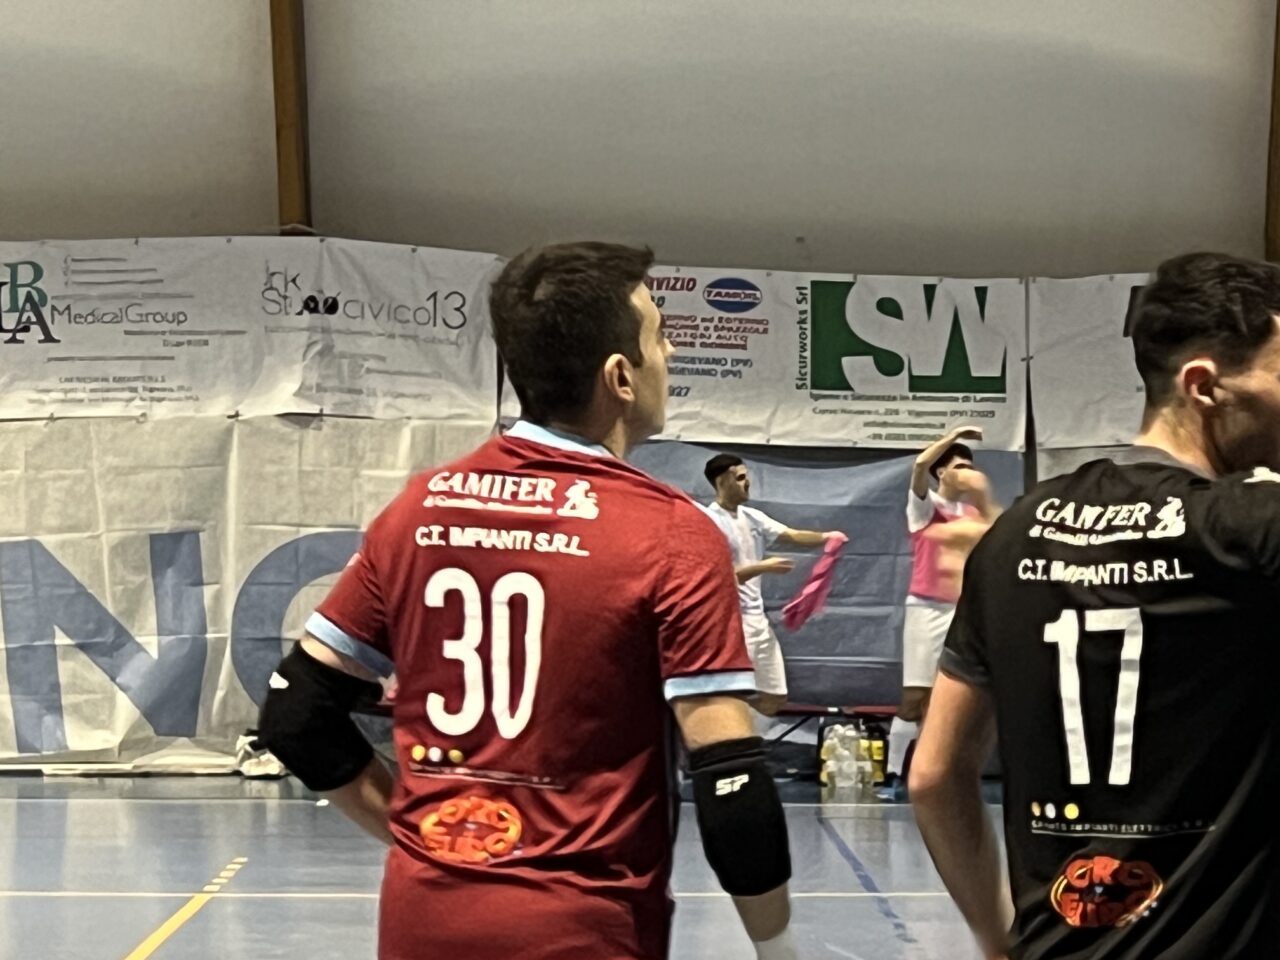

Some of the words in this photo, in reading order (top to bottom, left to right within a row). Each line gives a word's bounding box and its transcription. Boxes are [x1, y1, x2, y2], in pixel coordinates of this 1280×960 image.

[428, 471, 557, 502] GAMIFER
[424, 568, 545, 740] 30
[1043, 607, 1143, 785] 17
